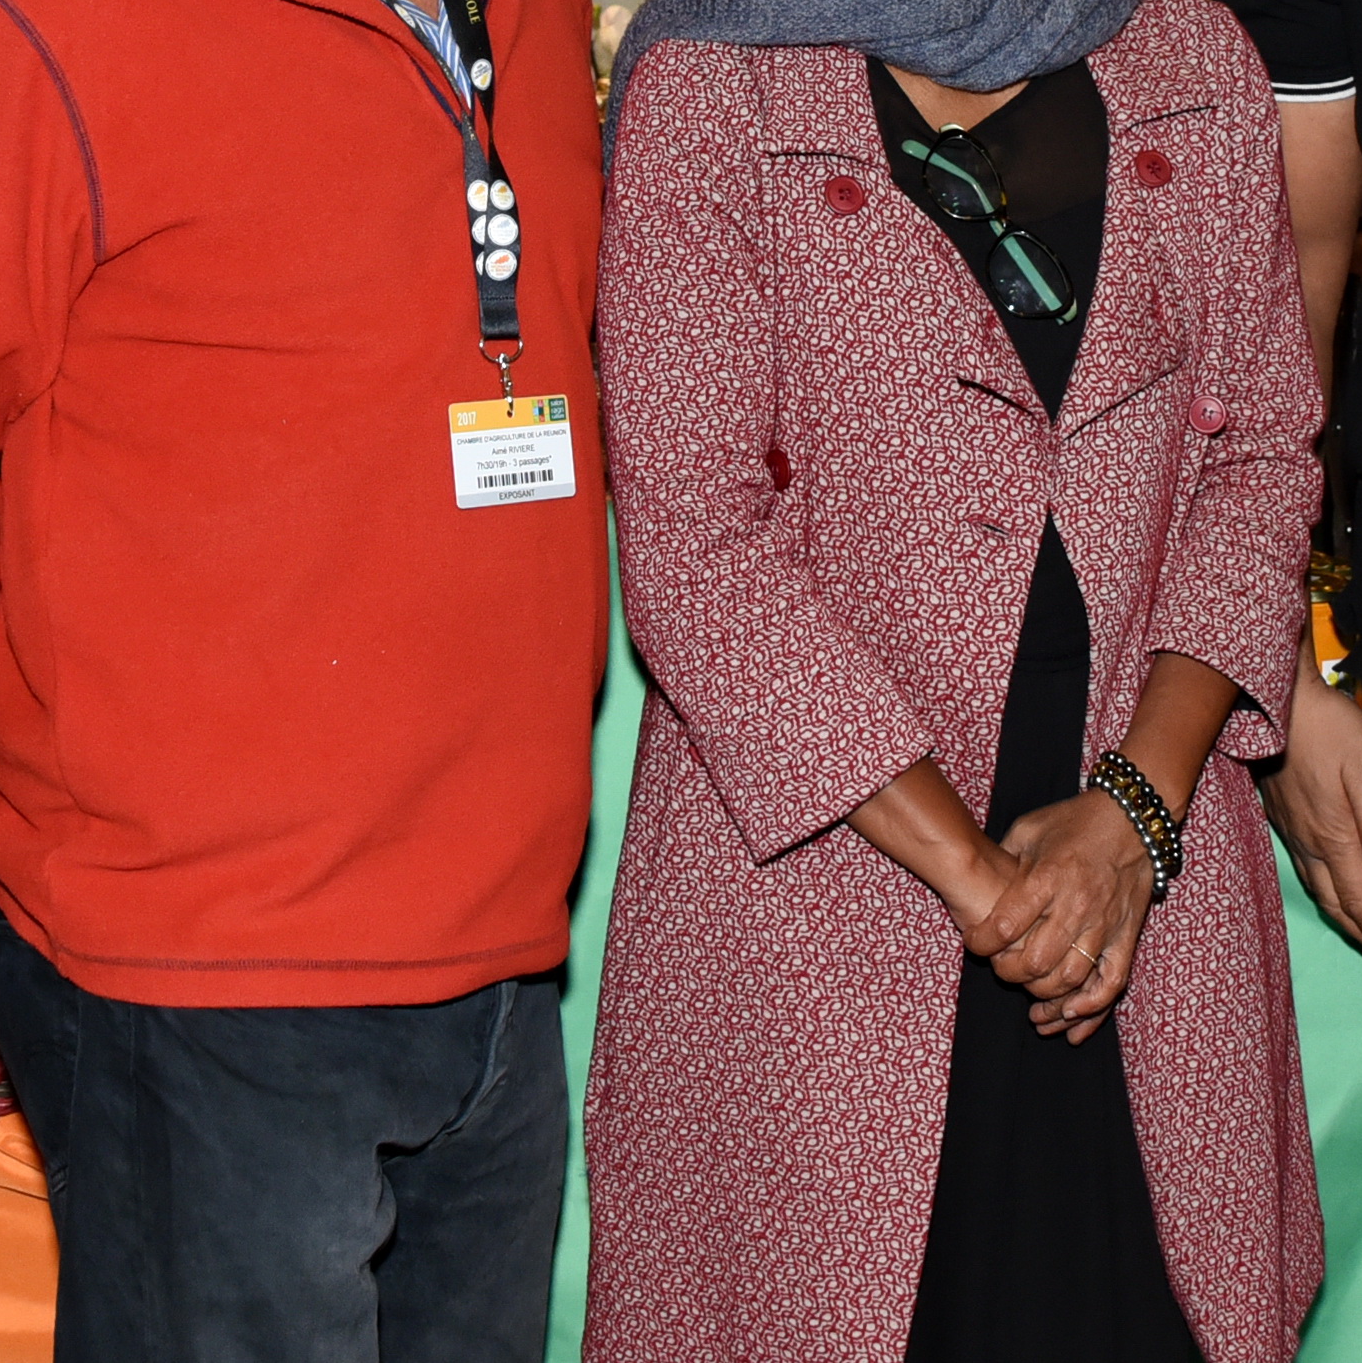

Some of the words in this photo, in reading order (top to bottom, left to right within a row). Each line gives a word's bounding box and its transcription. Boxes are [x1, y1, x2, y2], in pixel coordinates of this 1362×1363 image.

[457, 412, 477, 427] 2017
[457, 436, 483, 445] CHAMBRE
[484, 433, 526, 443] D'AGRICULTURE
[543, 429, 567, 437] REUNION
[491, 446, 508, 455] Aimé
[508, 444, 536, 454] RIVIERE
[476, 459, 508, 470] 7h30/19h
[498, 489, 535, 501] EXPOSANT
